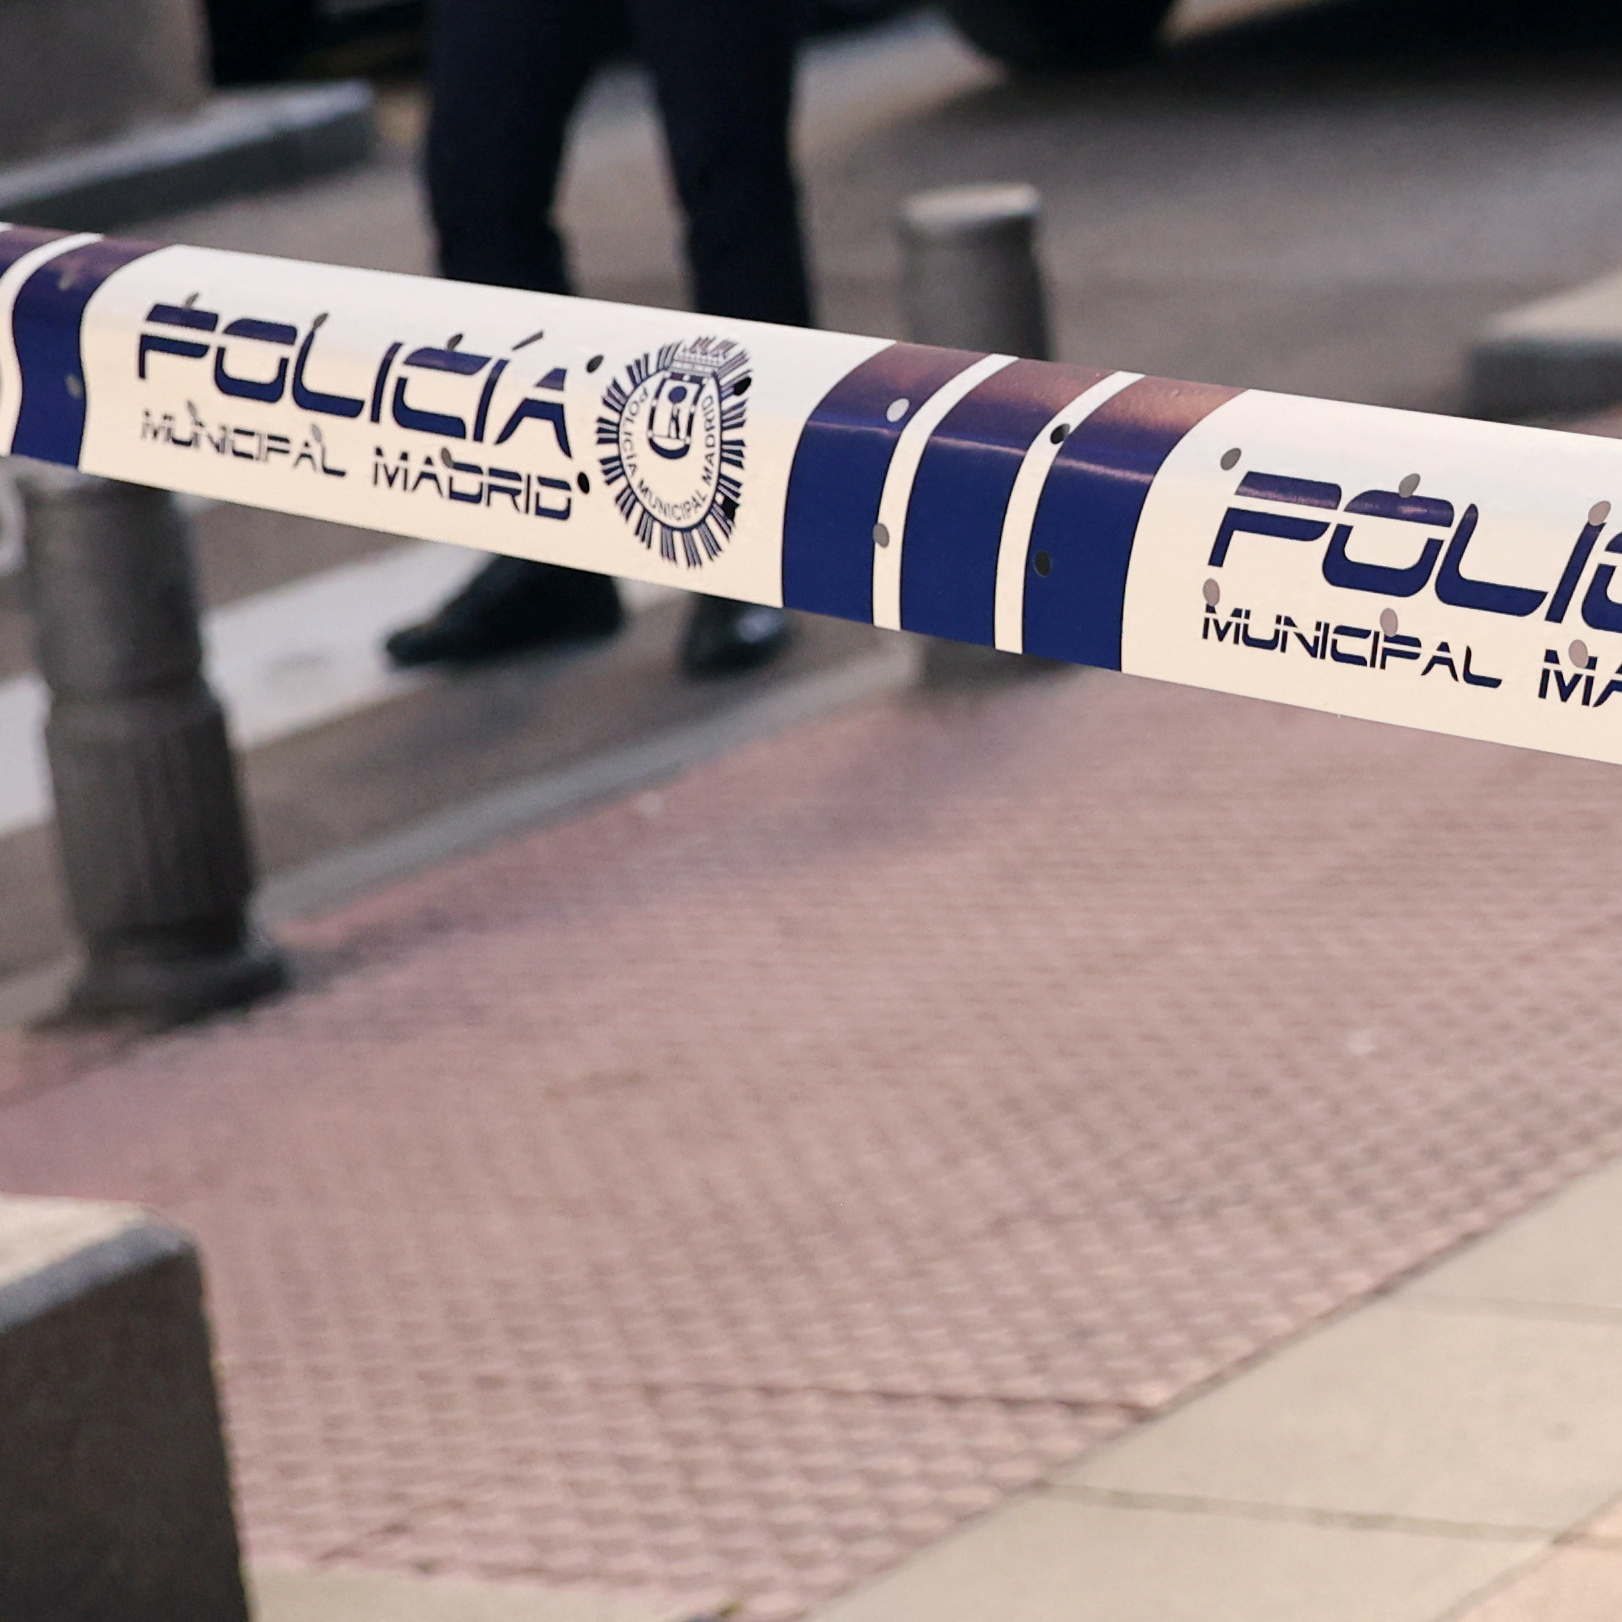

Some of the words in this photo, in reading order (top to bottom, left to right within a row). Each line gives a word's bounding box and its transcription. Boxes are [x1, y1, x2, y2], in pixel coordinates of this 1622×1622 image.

[137, 303, 572, 458] POLICÍA
[141, 410, 347, 478] MUNICIPAL
[373, 447, 573, 521] MADRID
[637, 478, 708, 521] MUNICIPAL
[701, 395, 716, 486] MADRID
[1202, 605, 1502, 688] MUNICIPAL
